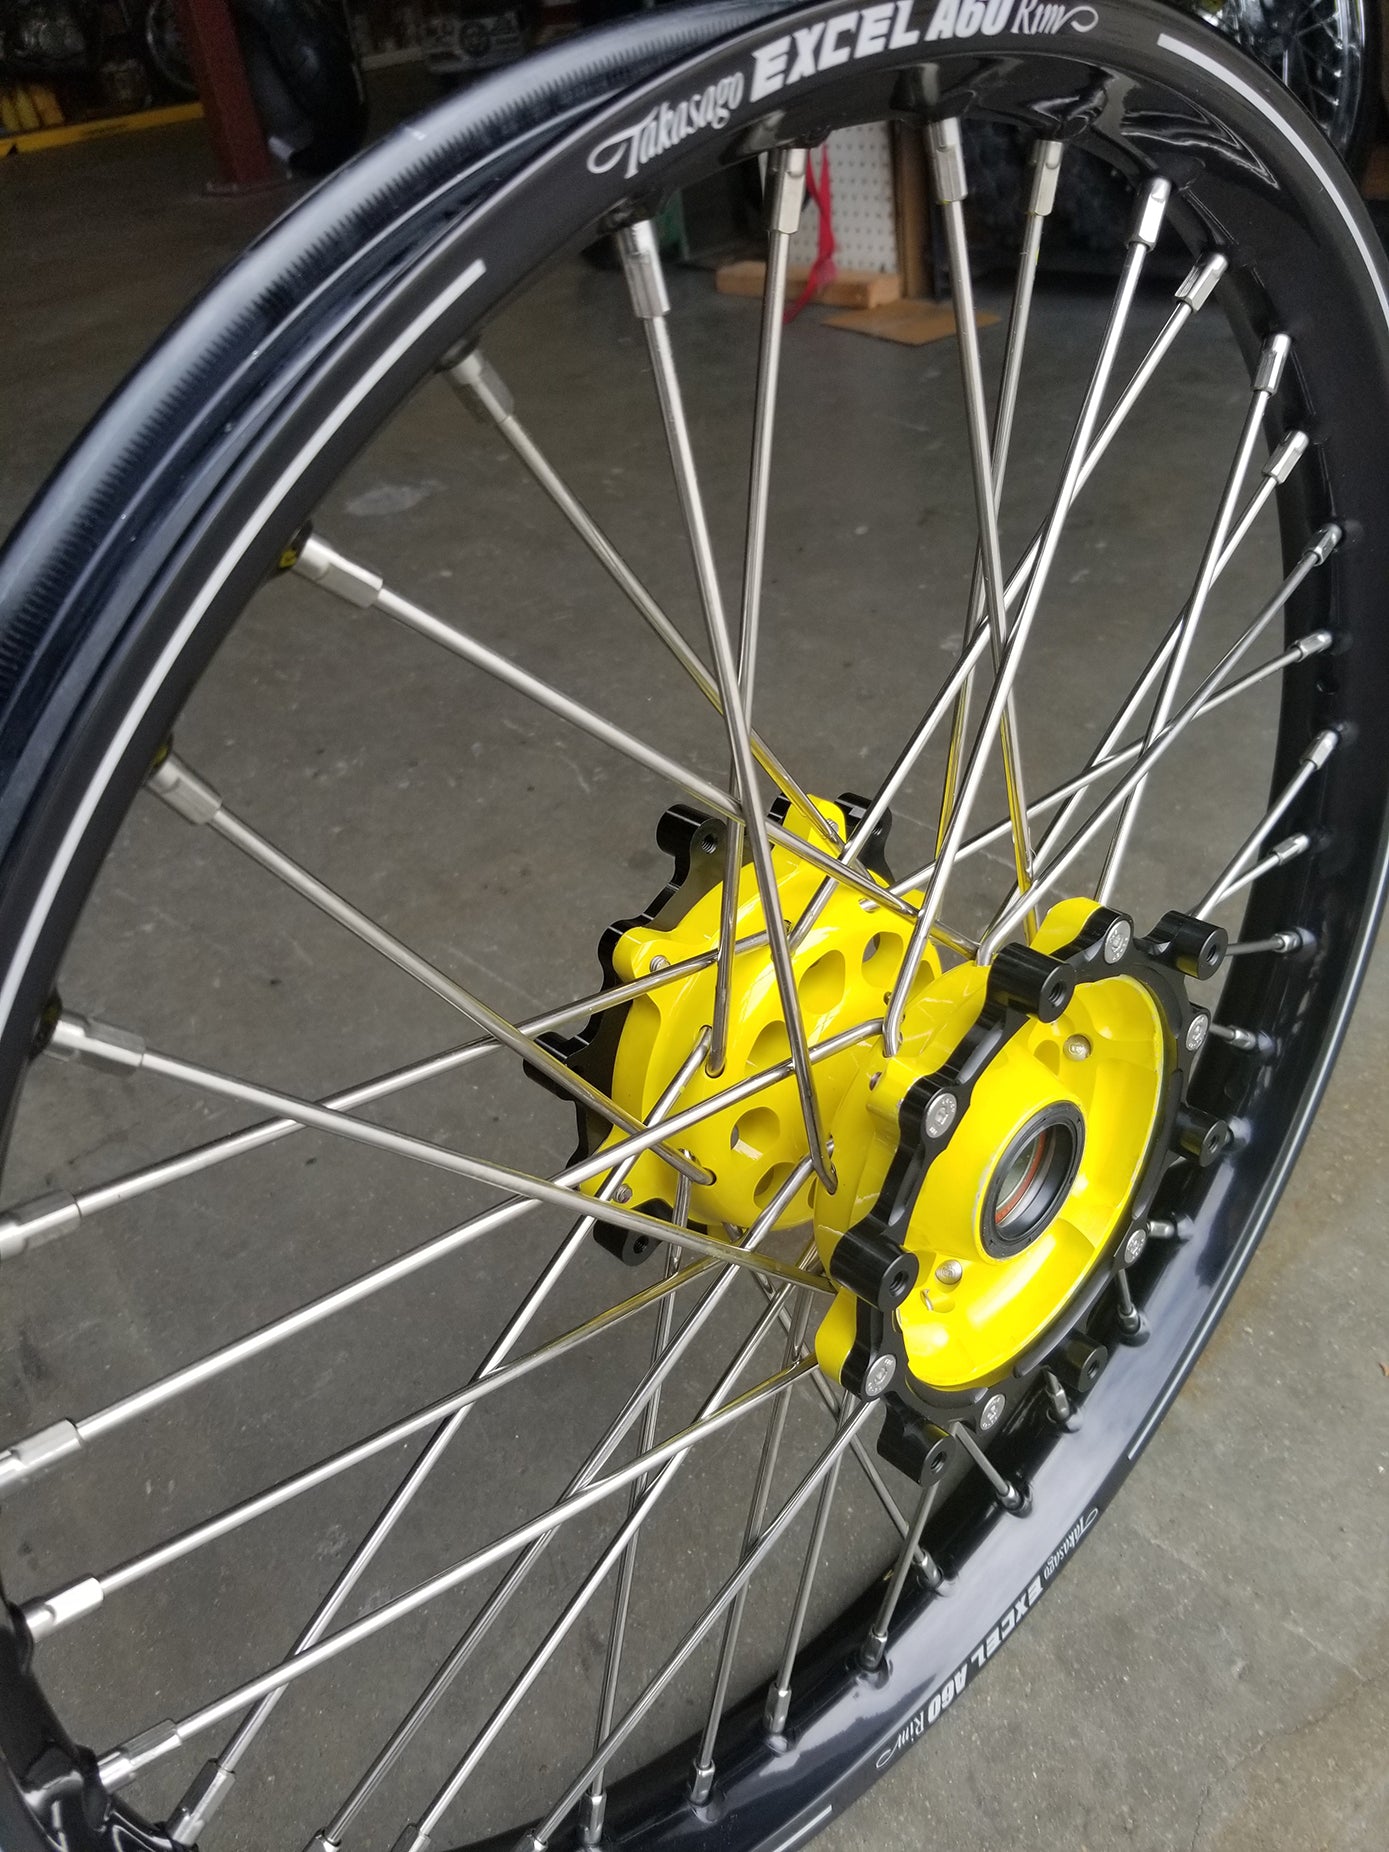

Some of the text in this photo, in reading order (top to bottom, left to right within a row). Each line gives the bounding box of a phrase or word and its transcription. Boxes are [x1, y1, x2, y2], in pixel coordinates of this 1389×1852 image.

[587, 0, 1099, 179] Takasago EXCEL A60 Rim
[876, 1508, 1098, 1768] Takasago EXCEL A60 Rim
